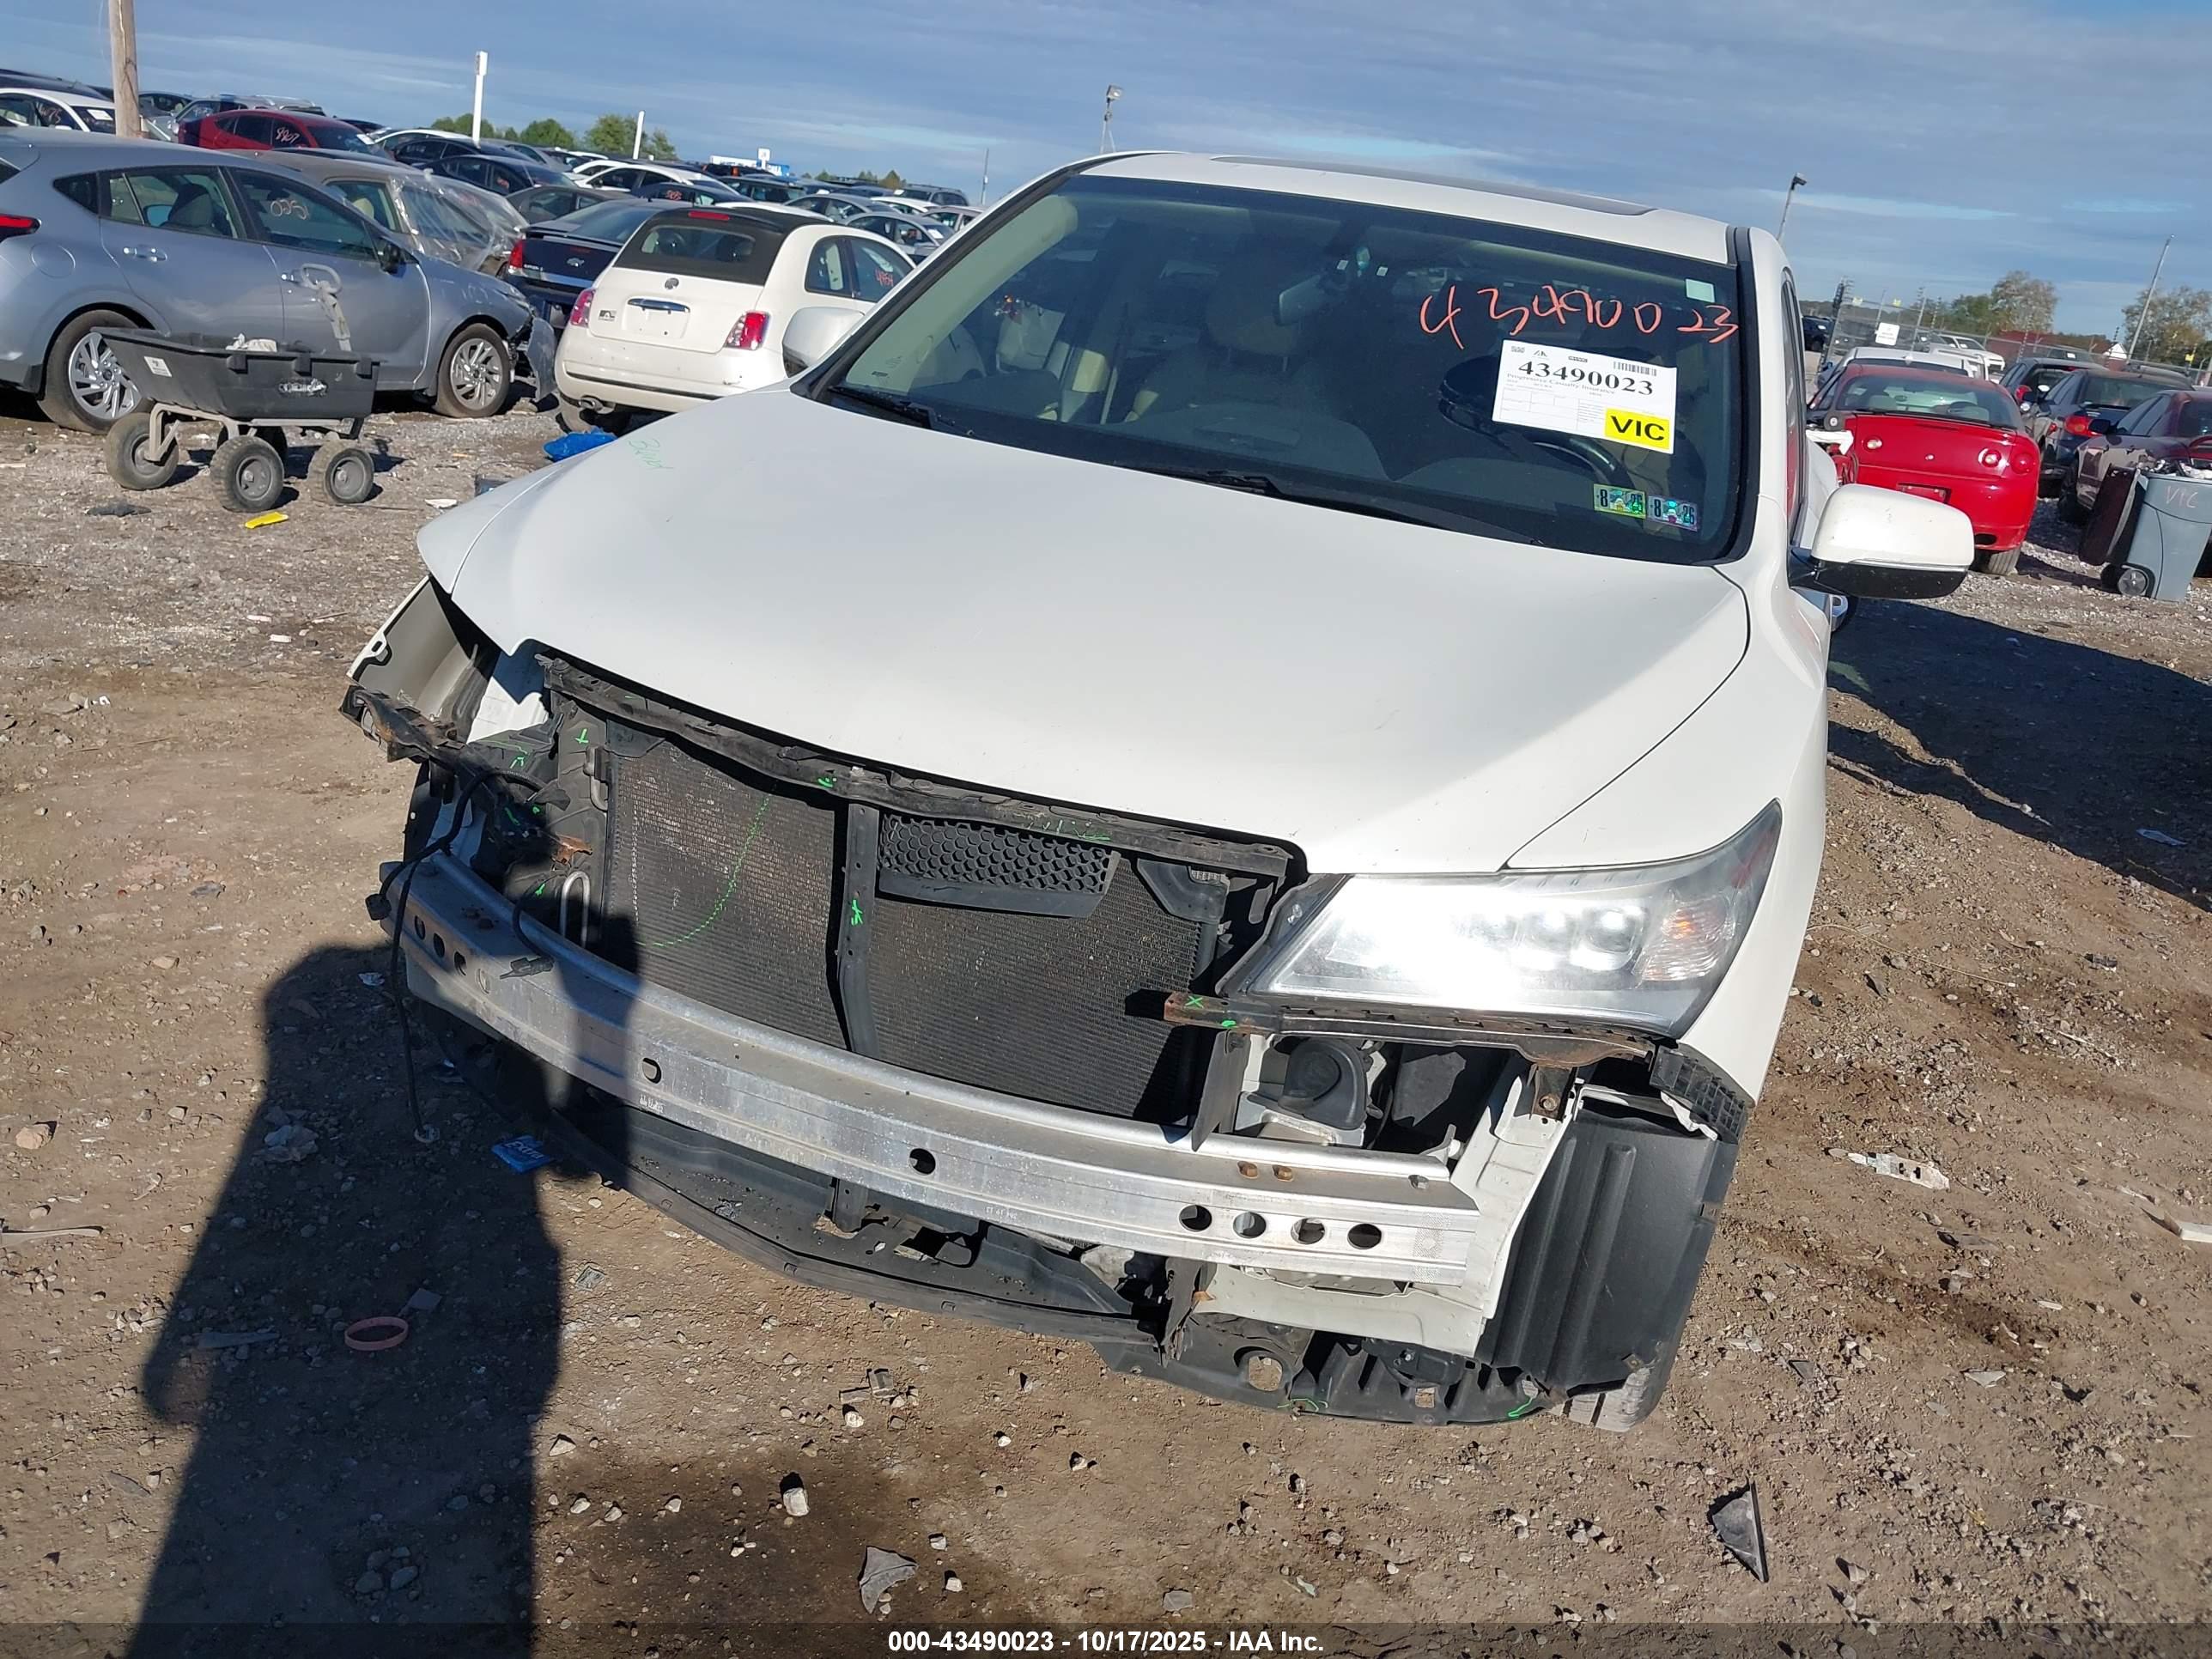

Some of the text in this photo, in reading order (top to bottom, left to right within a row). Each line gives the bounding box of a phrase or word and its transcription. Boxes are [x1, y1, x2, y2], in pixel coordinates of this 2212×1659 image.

[1517, 361, 1654, 396] 43490023
[1610, 415, 1665, 442] VIC
[1600, 489, 1608, 507] 8
[1654, 499, 1695, 525] 8 26
